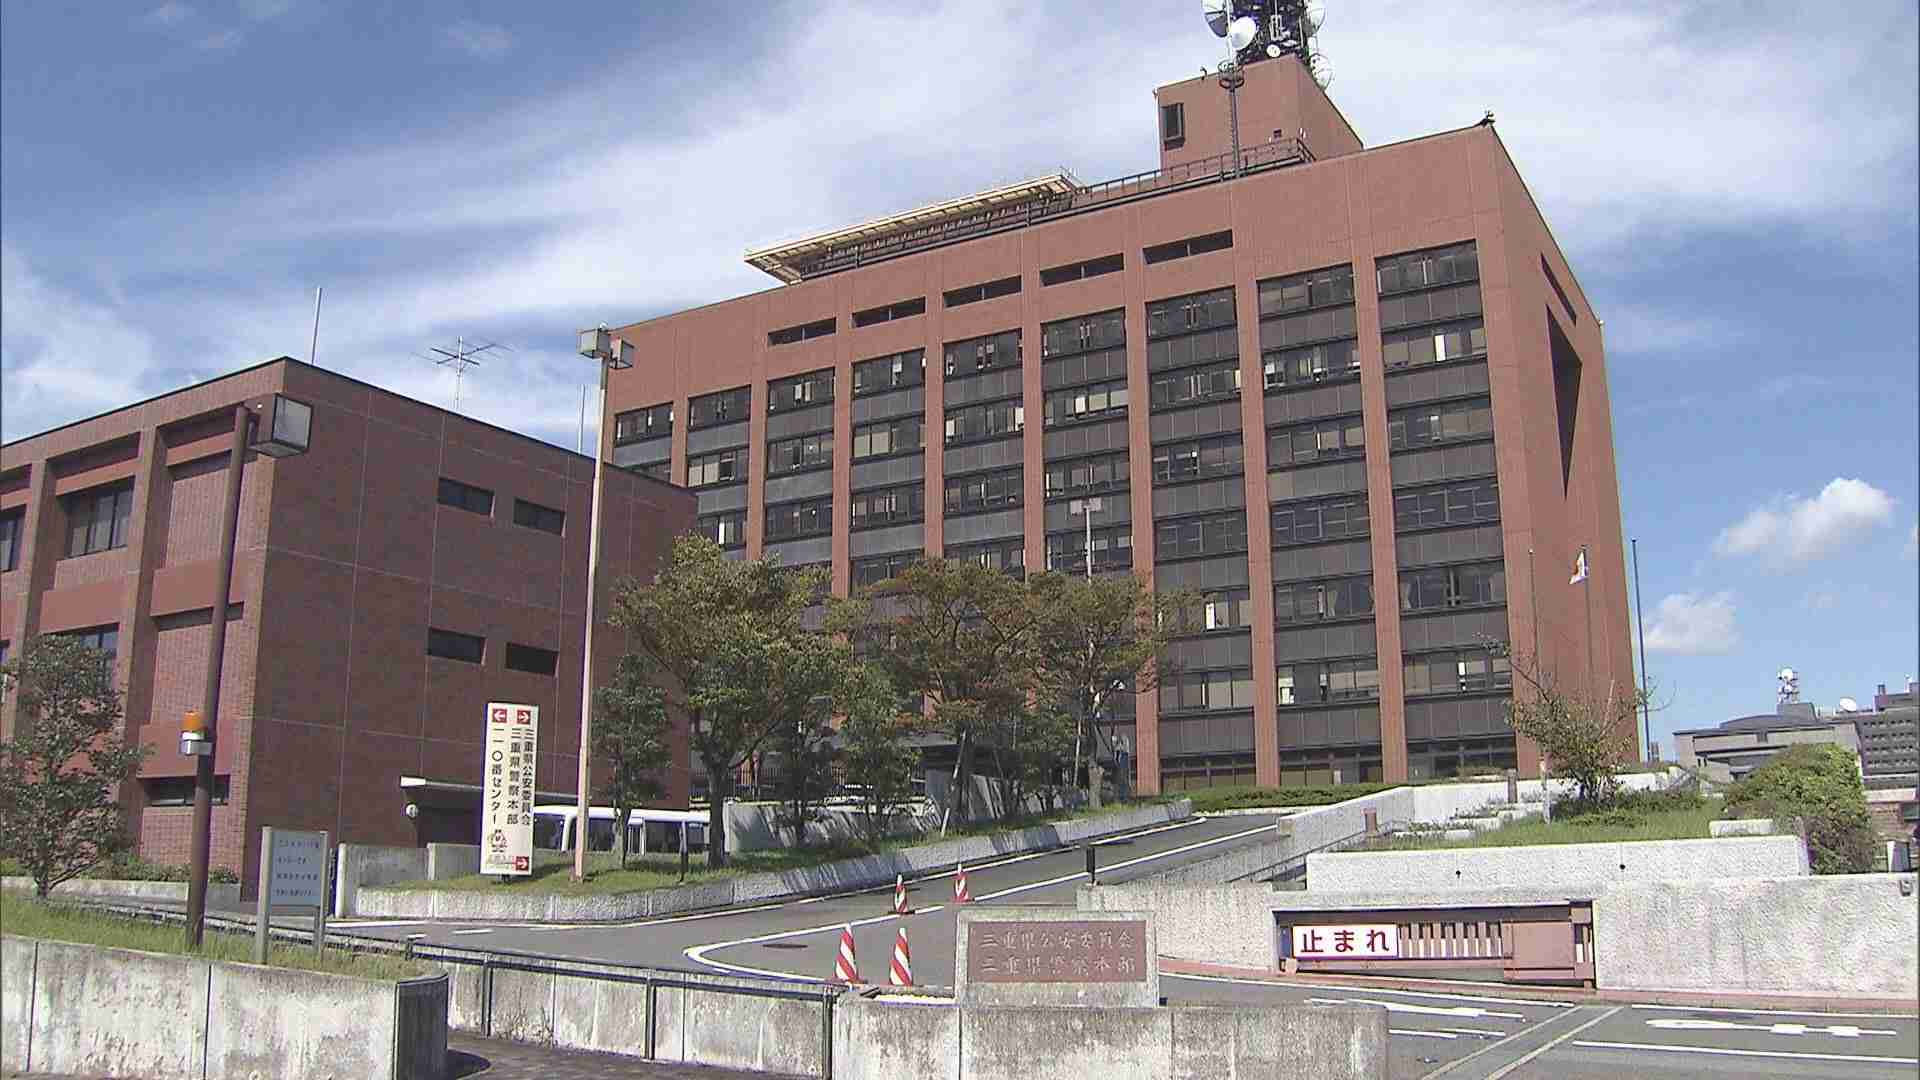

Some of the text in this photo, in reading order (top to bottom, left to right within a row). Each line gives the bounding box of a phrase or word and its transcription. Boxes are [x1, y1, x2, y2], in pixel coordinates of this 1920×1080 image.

[507, 728, 521, 825] 三重県警察本部
[520, 728, 534, 826] 三重県公安委員会
[978, 930, 1135, 950] 三重県公安委員会
[1301, 929, 1390, 953] 止まれ
[980, 954, 1136, 975] 三重県警察本部
